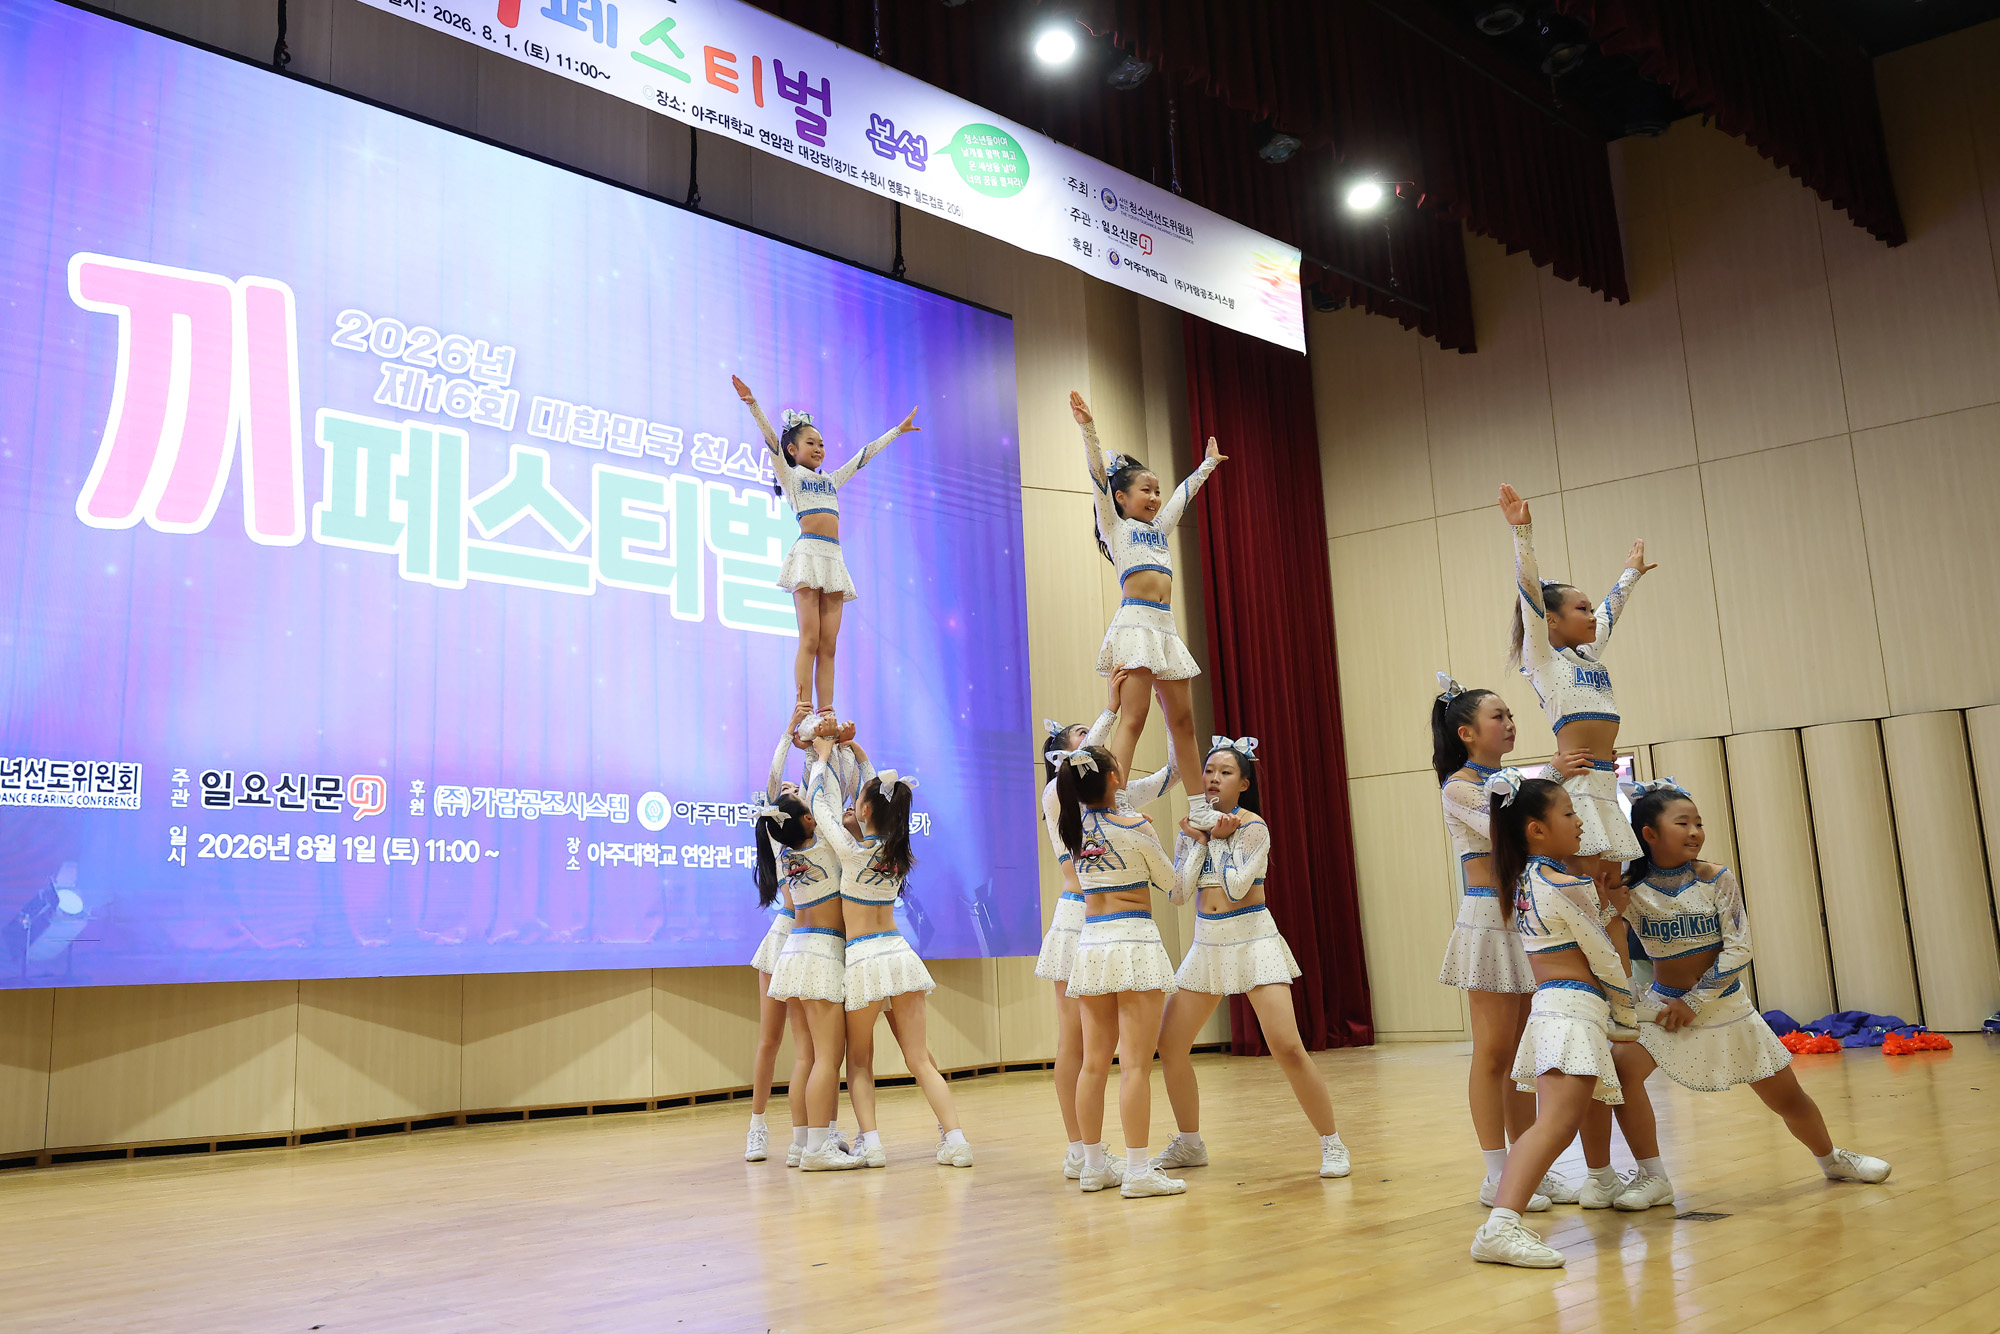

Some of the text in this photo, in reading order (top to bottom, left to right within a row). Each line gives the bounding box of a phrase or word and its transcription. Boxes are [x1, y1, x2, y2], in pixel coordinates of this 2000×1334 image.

[433, 5, 476, 35] 2026.
[482, 25, 497, 43] 8.
[504, 34, 518, 51] 1.
[524, 39, 550, 63] (토)
[556, 53, 611, 80] 11:00~
[656, 89, 964, 218] 장소: 아주대학교 연암관 대강당(경기도 수원시 영통구 월드컵로 206)
[866, 113, 928, 172] 본선
[963, 133, 1009, 147] 청소년들이여
[1067, 176, 1088, 198] 주최
[1070, 206, 1092, 228] 주관
[1101, 220, 1139, 246] 일요신문
[1129, 201, 1194, 240] 청소년선도위원회
[1072, 237, 1093, 258] 후원
[1123, 257, 1235, 310] 아주대학교 (주)가람공조시스템
[331, 308, 517, 387] 2026년
[67, 251, 306, 547] 끼
[373, 361, 521, 431] 제16회
[527, 395, 684, 467] 대한민국
[801, 479, 826, 493] Angel
[312, 408, 801, 638] 페스티벌
[1132, 530, 1160, 546] Angel
[0, 793, 139, 808] ANCE REARING CONFERENCE
[200, 769, 346, 812] 일요신문
[434, 785, 630, 824] (주)가람공조시스템
[909, 812, 932, 836] 카
[197, 832, 291, 862] 2026년
[296, 834, 337, 863] 8월
[342, 835, 376, 863] 1일
[383, 837, 420, 865] (토)
[425, 838, 481, 863] 11:00
[587, 841, 679, 868] 아주대학교
[680, 843, 733, 869] 연암관
[1641, 915, 1686, 942] Angel
